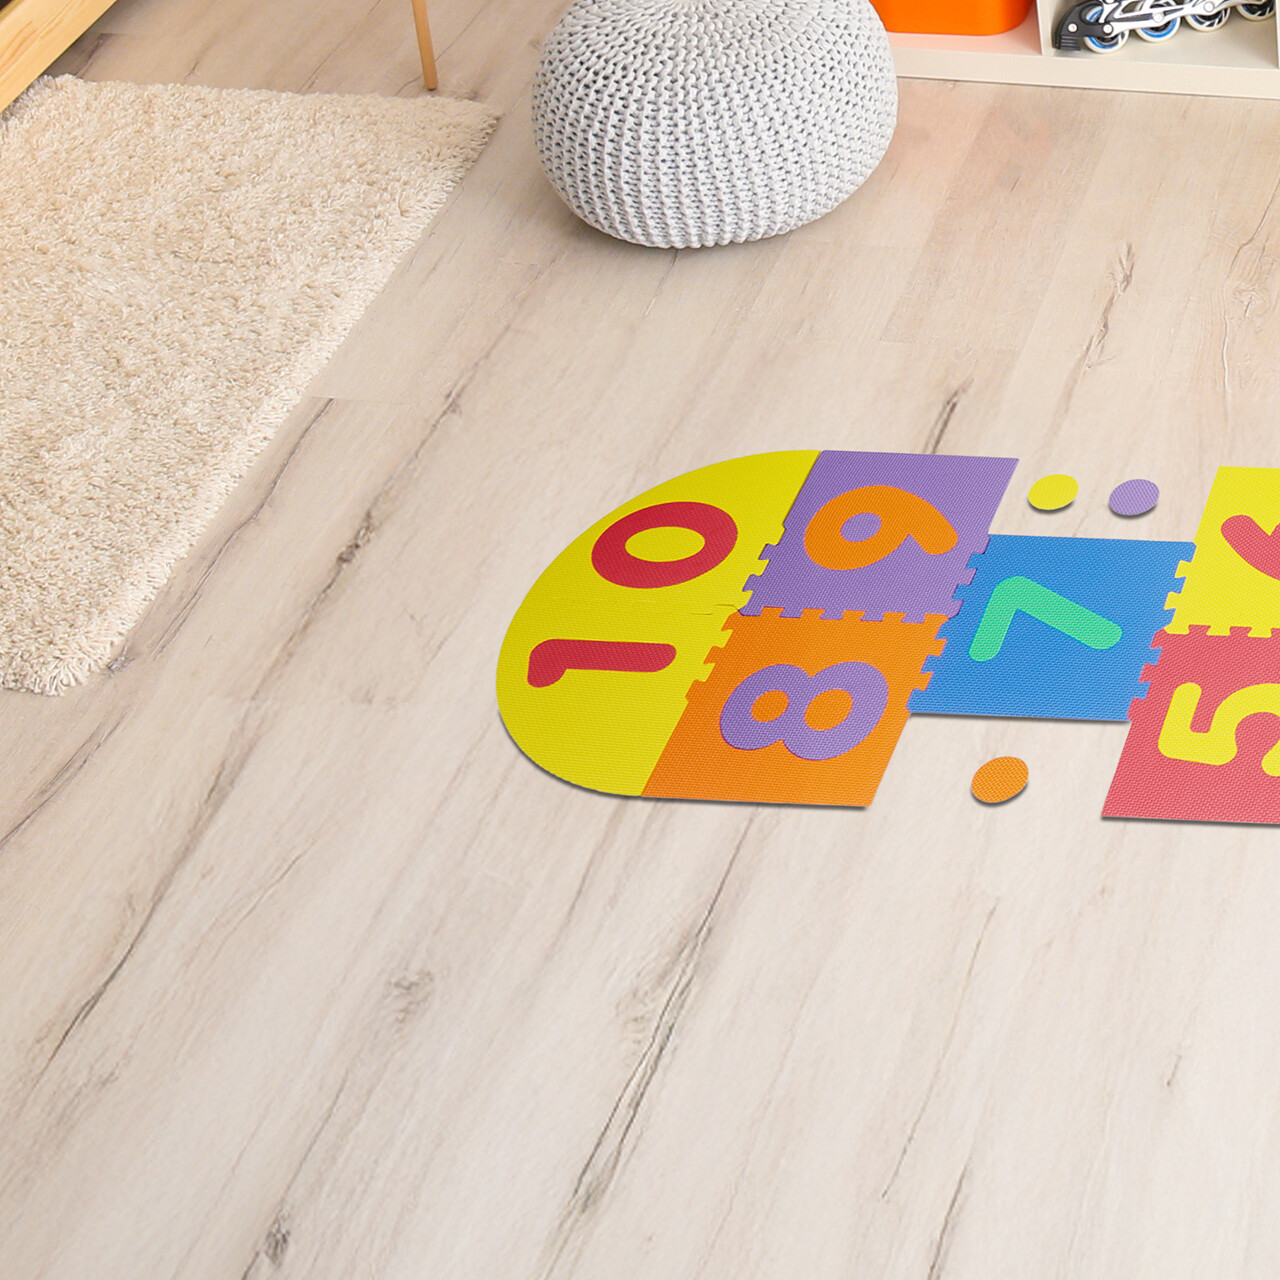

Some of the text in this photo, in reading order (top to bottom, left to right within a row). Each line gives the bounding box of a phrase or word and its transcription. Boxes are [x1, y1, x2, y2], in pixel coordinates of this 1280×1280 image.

[804, 485, 958, 570] 9
[527, 501, 738, 688] 10
[969, 576, 1122, 661] 7
[719, 661, 889, 761] 8
